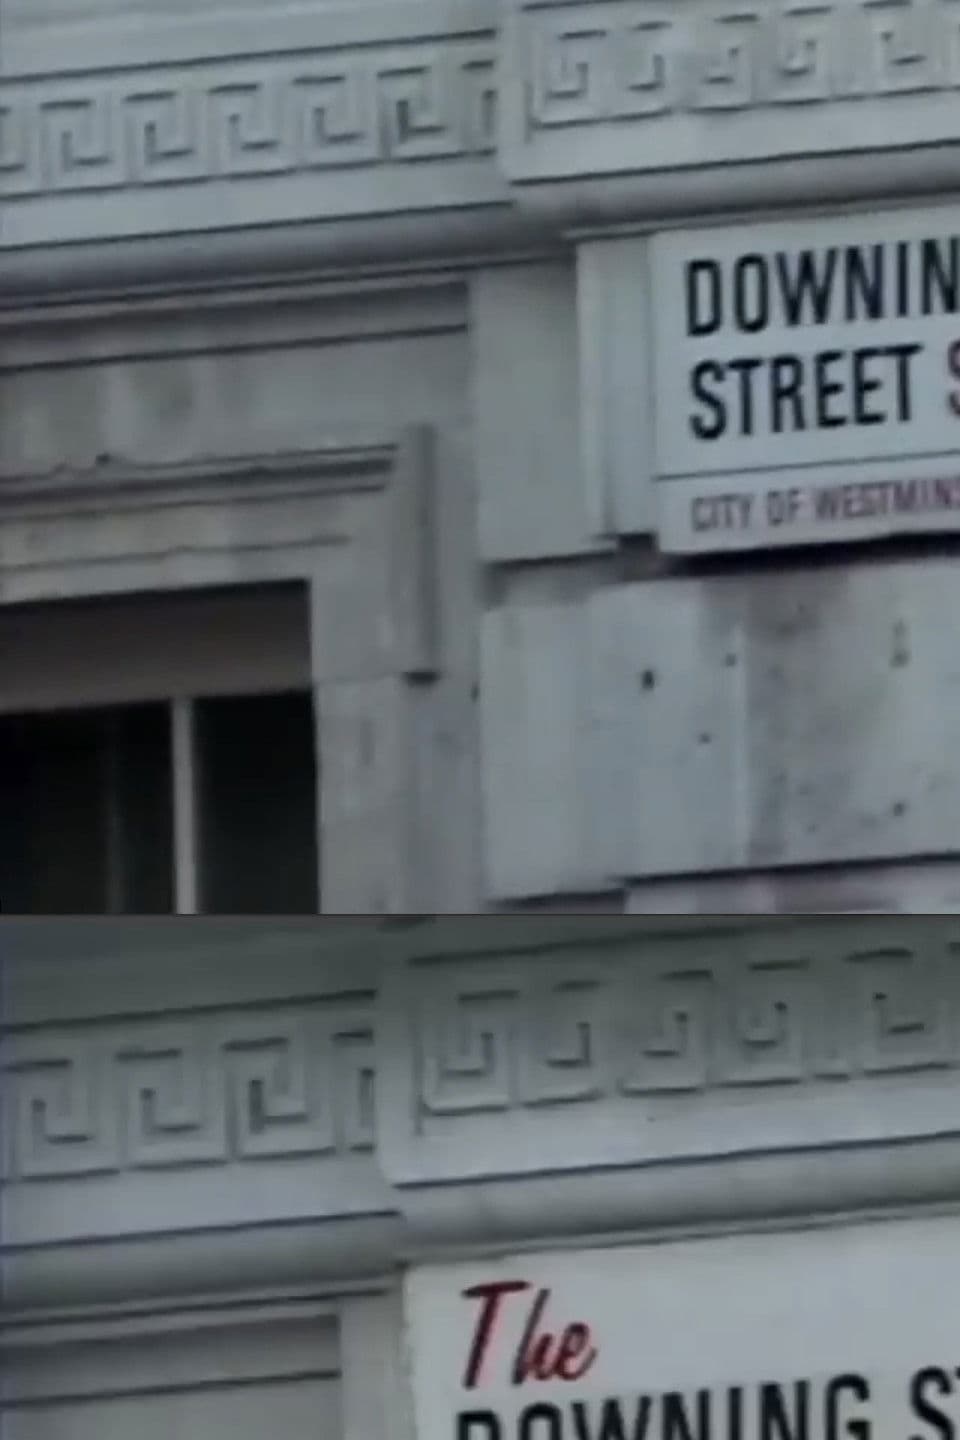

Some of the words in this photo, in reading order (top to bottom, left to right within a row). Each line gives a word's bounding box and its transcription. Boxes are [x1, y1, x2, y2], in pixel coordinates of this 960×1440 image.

[688, 343, 924, 441] STREET
[691, 493, 752, 532] CITY
[766, 487, 801, 527] OF
[460, 1280, 596, 1389] The
